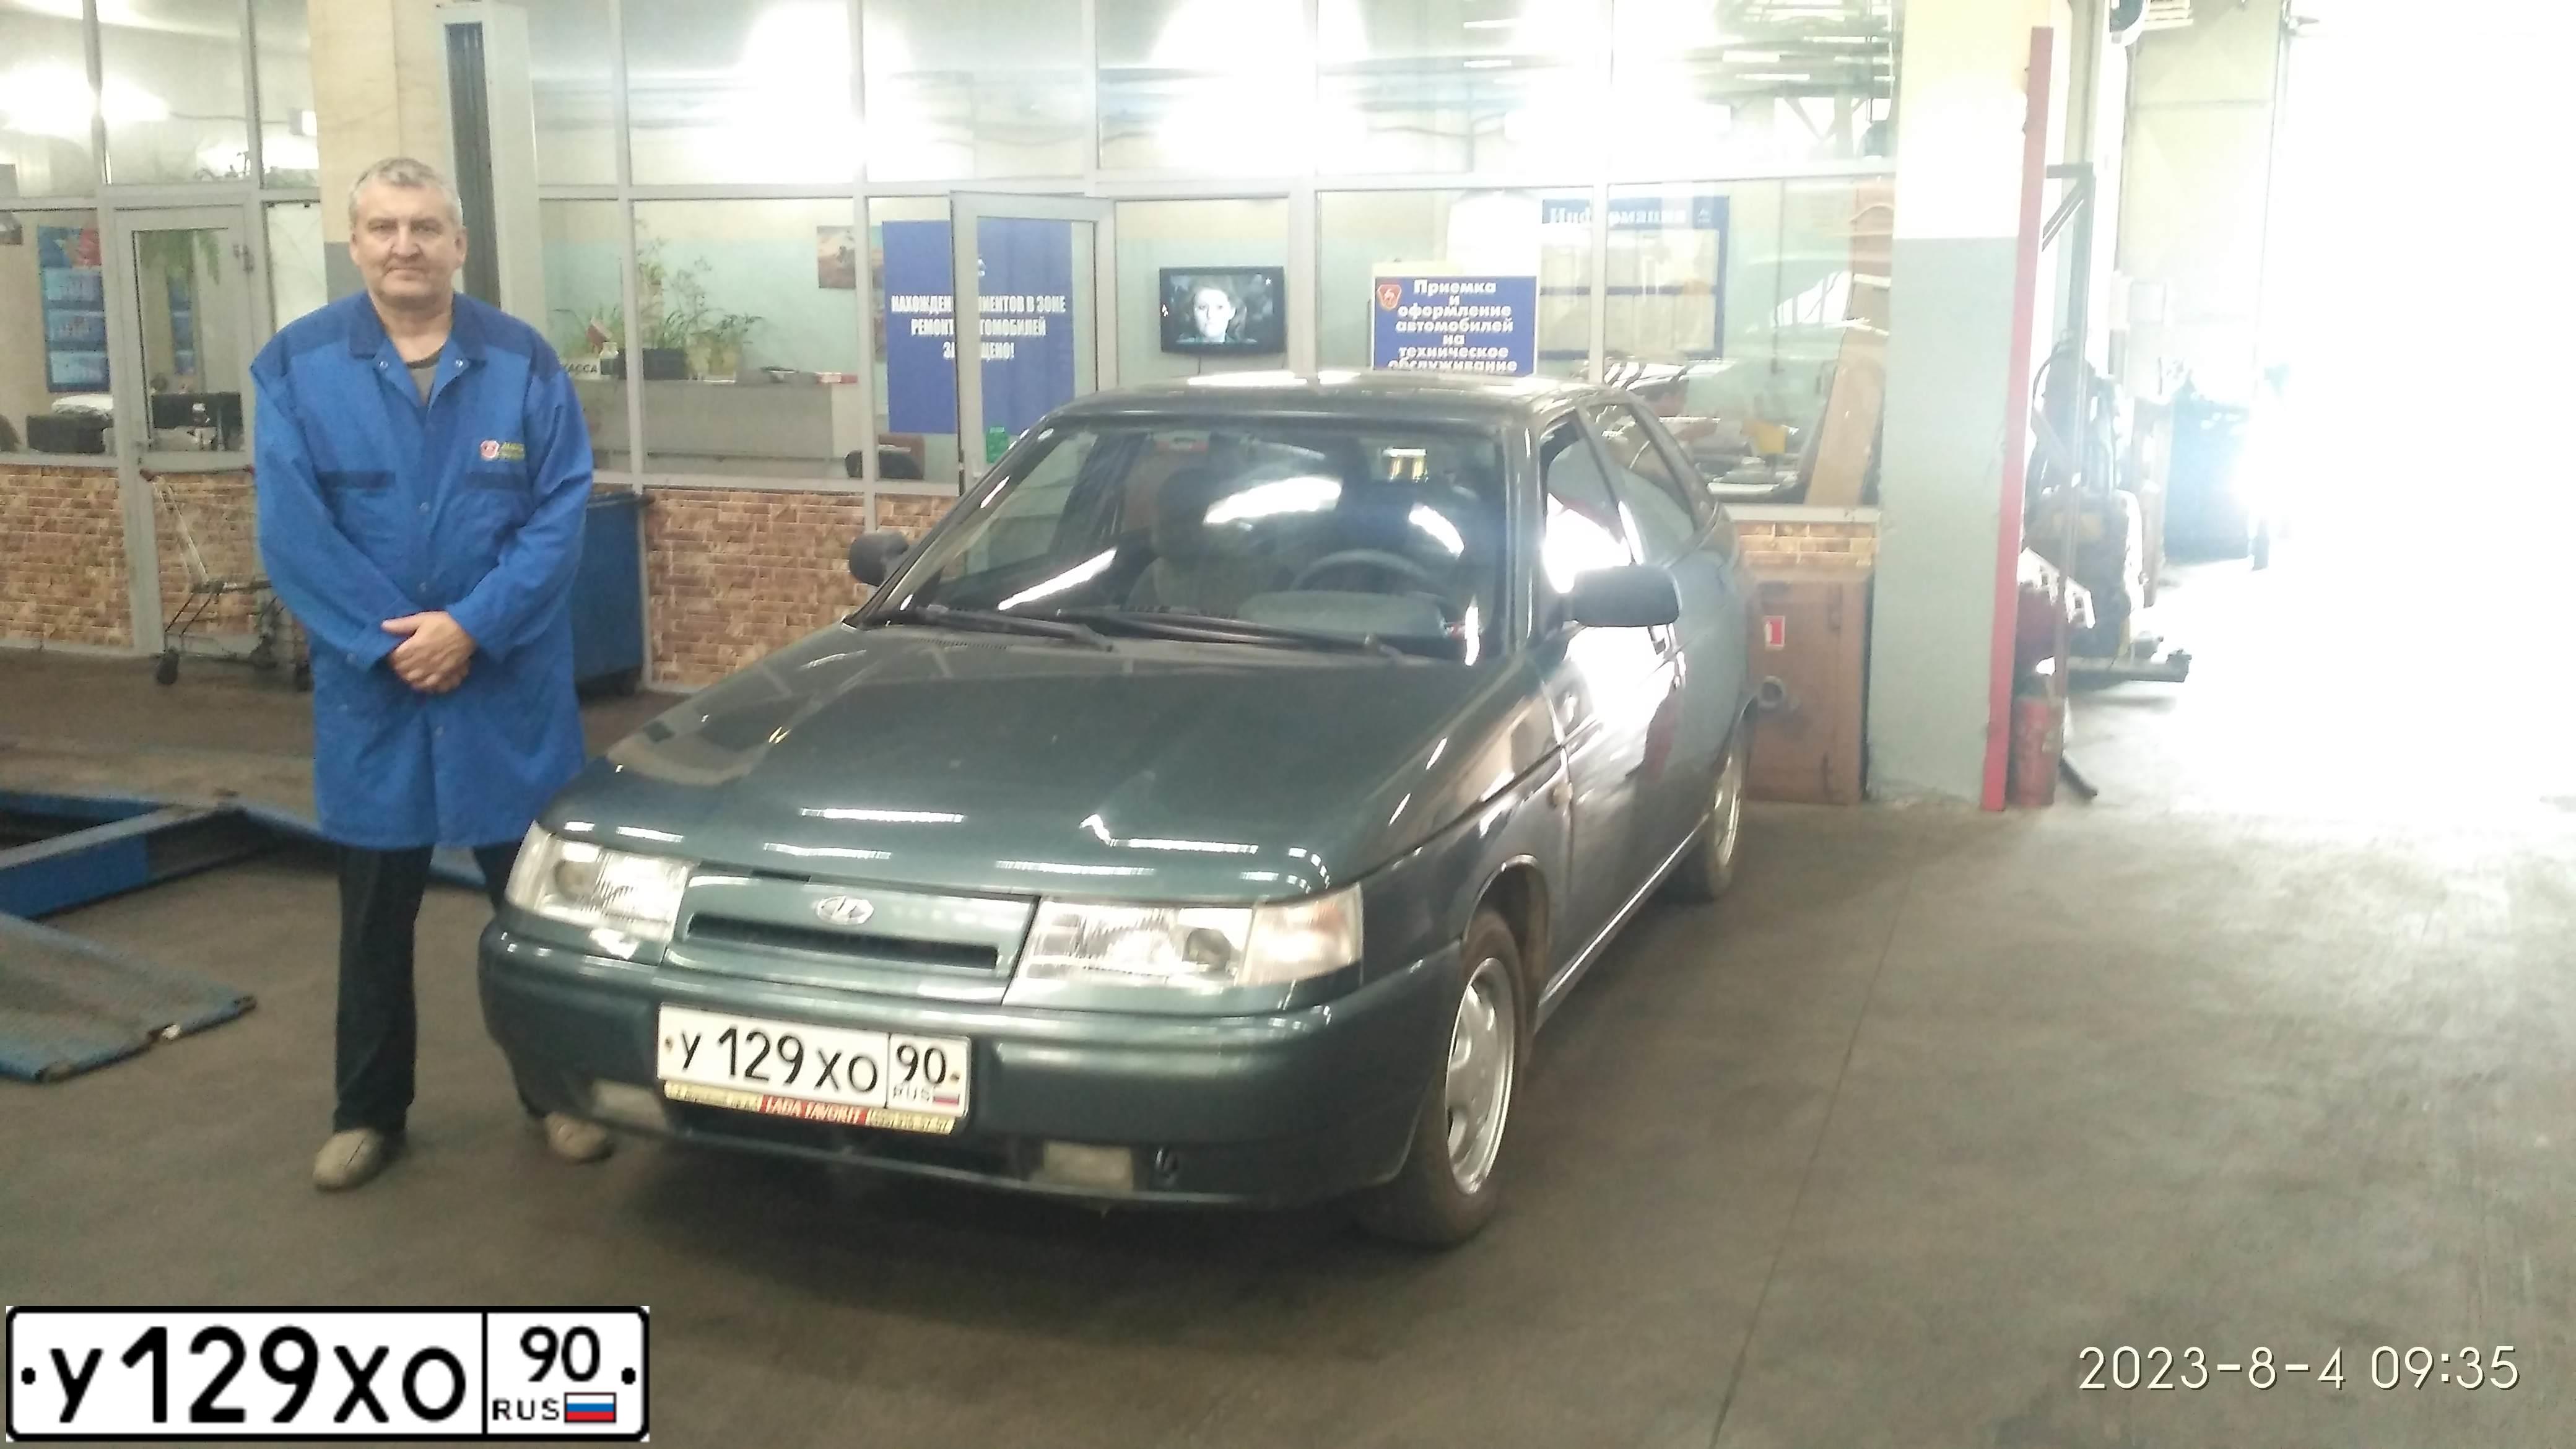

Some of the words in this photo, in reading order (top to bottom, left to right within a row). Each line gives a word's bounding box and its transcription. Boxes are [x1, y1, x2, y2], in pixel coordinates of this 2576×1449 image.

[1550, 207, 1686, 227] Инфрмация
[1414, 280, 1496, 297] Приемка
[891, 295, 954, 315] НАХОЖДЕН
[978, 295, 1024, 313] ИЕНТОВ
[1027, 295, 1034, 312] В
[1037, 295, 1066, 312] ЗОНЕ
[1449, 295, 1460, 305] и
[1398, 303, 1512, 319] оформление
[911, 318, 954, 336] РЕМОНТ
[980, 316, 1046, 336] ТОМОБИЛЕЙ
[1396, 317, 1513, 333] автомобилей
[1443, 334, 1465, 346] на
[1398, 346, 1508, 358] техническое
[564, 363, 597, 373] АССА
[1388, 357, 1517, 372] обслуживание
[896, 1044, 947, 1085] 90
[765, 1095, 803, 1117] LADA
